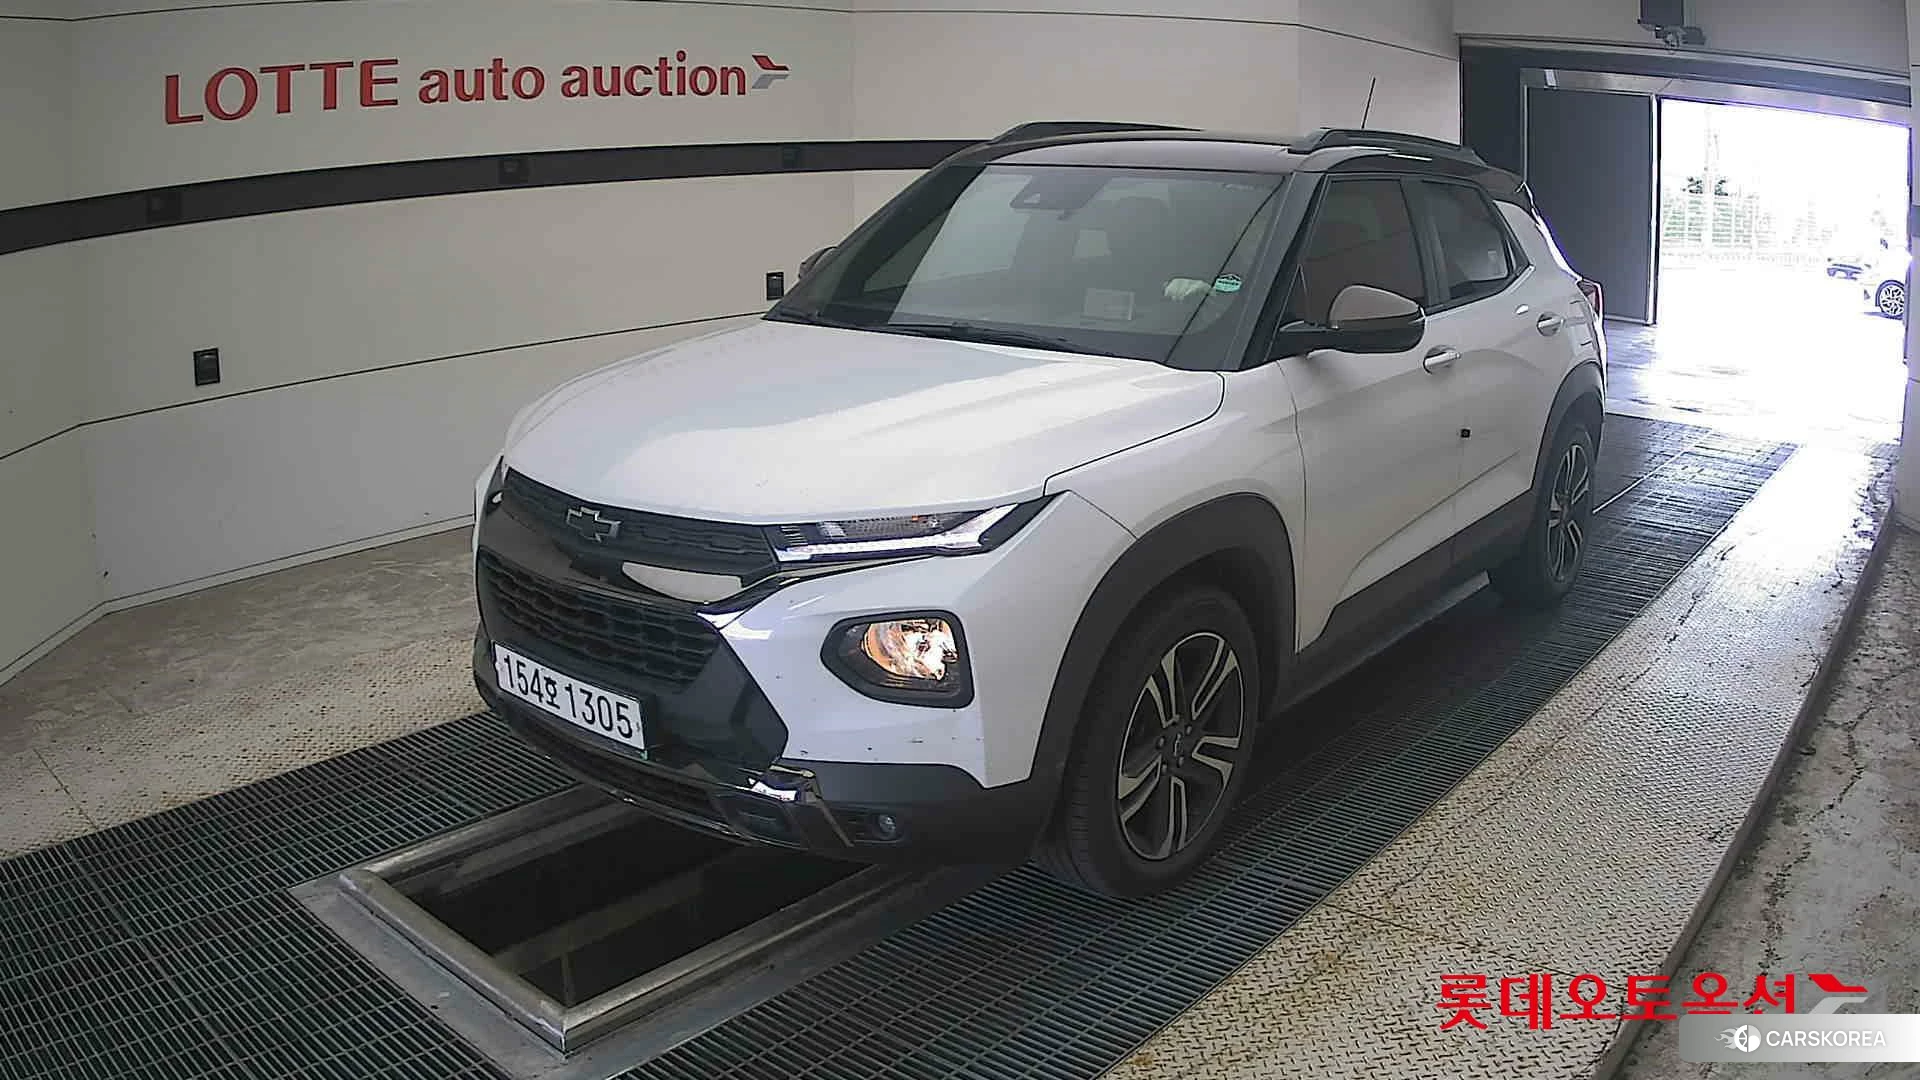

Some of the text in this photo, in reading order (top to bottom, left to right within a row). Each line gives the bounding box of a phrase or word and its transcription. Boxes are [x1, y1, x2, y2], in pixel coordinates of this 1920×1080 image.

[165, 50, 748, 124] LOTTE auto auction
